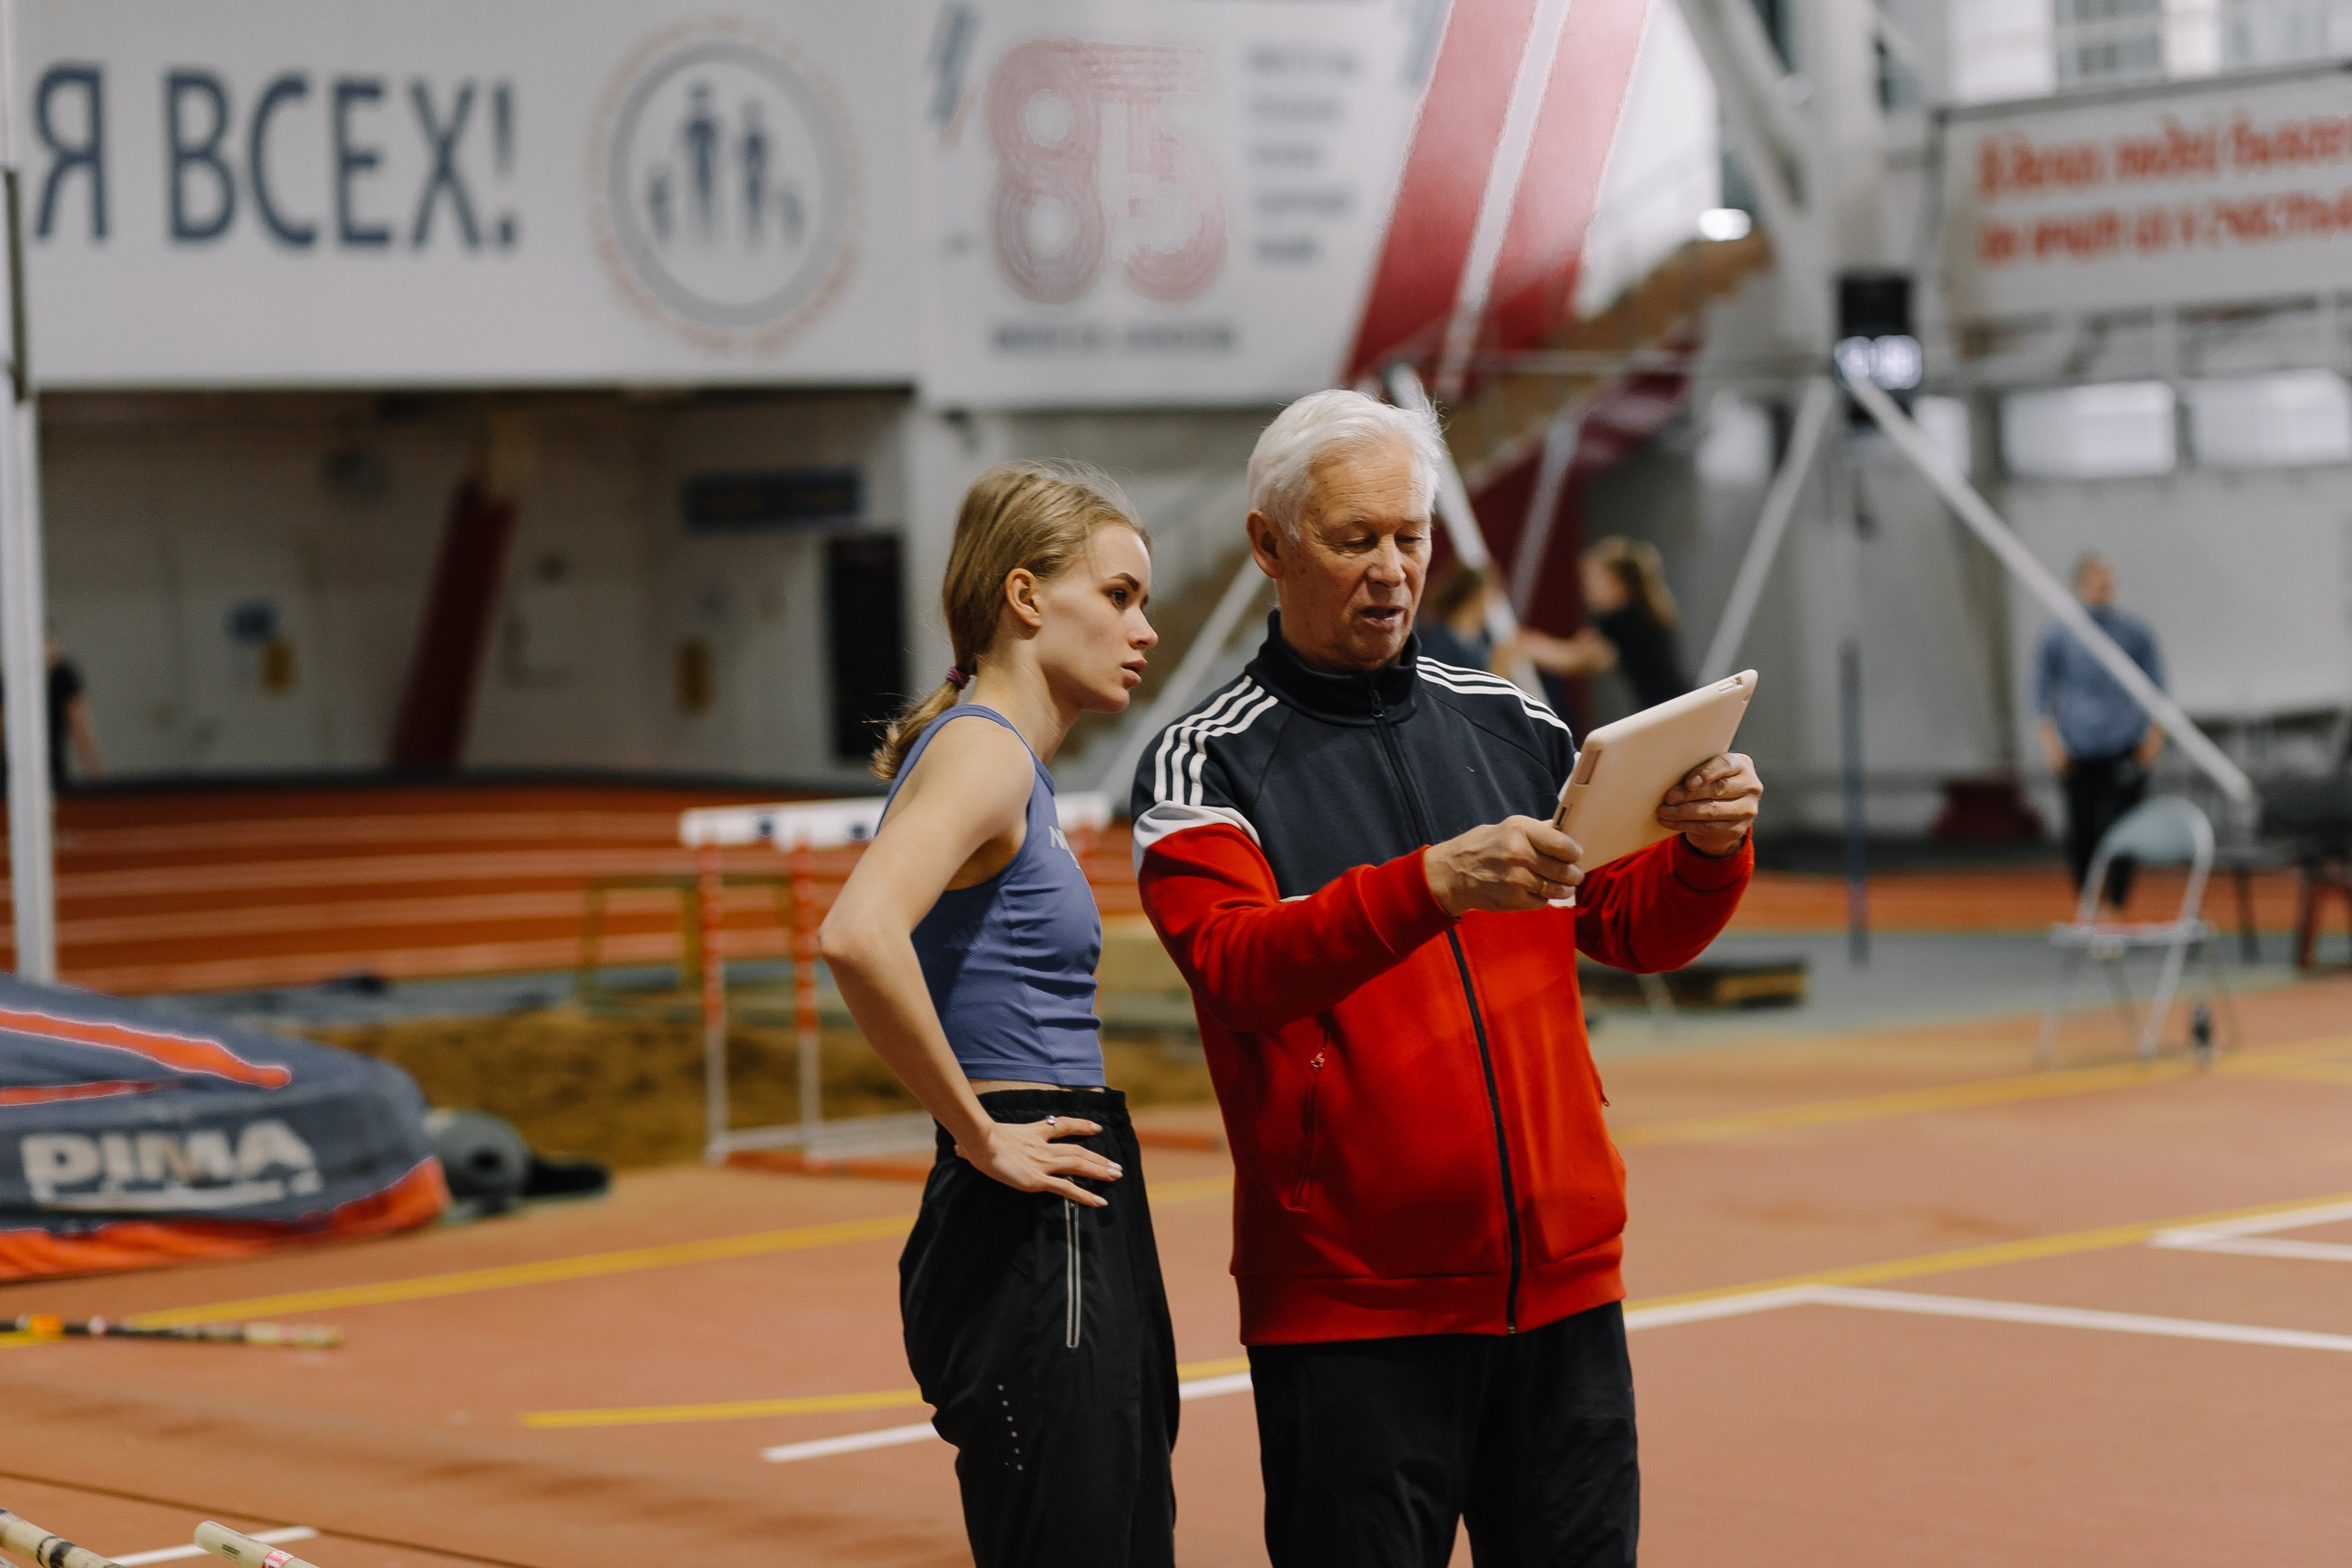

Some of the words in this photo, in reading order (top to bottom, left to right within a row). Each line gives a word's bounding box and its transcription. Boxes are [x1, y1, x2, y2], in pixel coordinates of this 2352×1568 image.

[33, 62, 109, 243] Я
[164, 66, 518, 252] ВСЕХ!
[985, 39, 1228, 305] 85
[21, 1121, 322, 1203] PIMA
